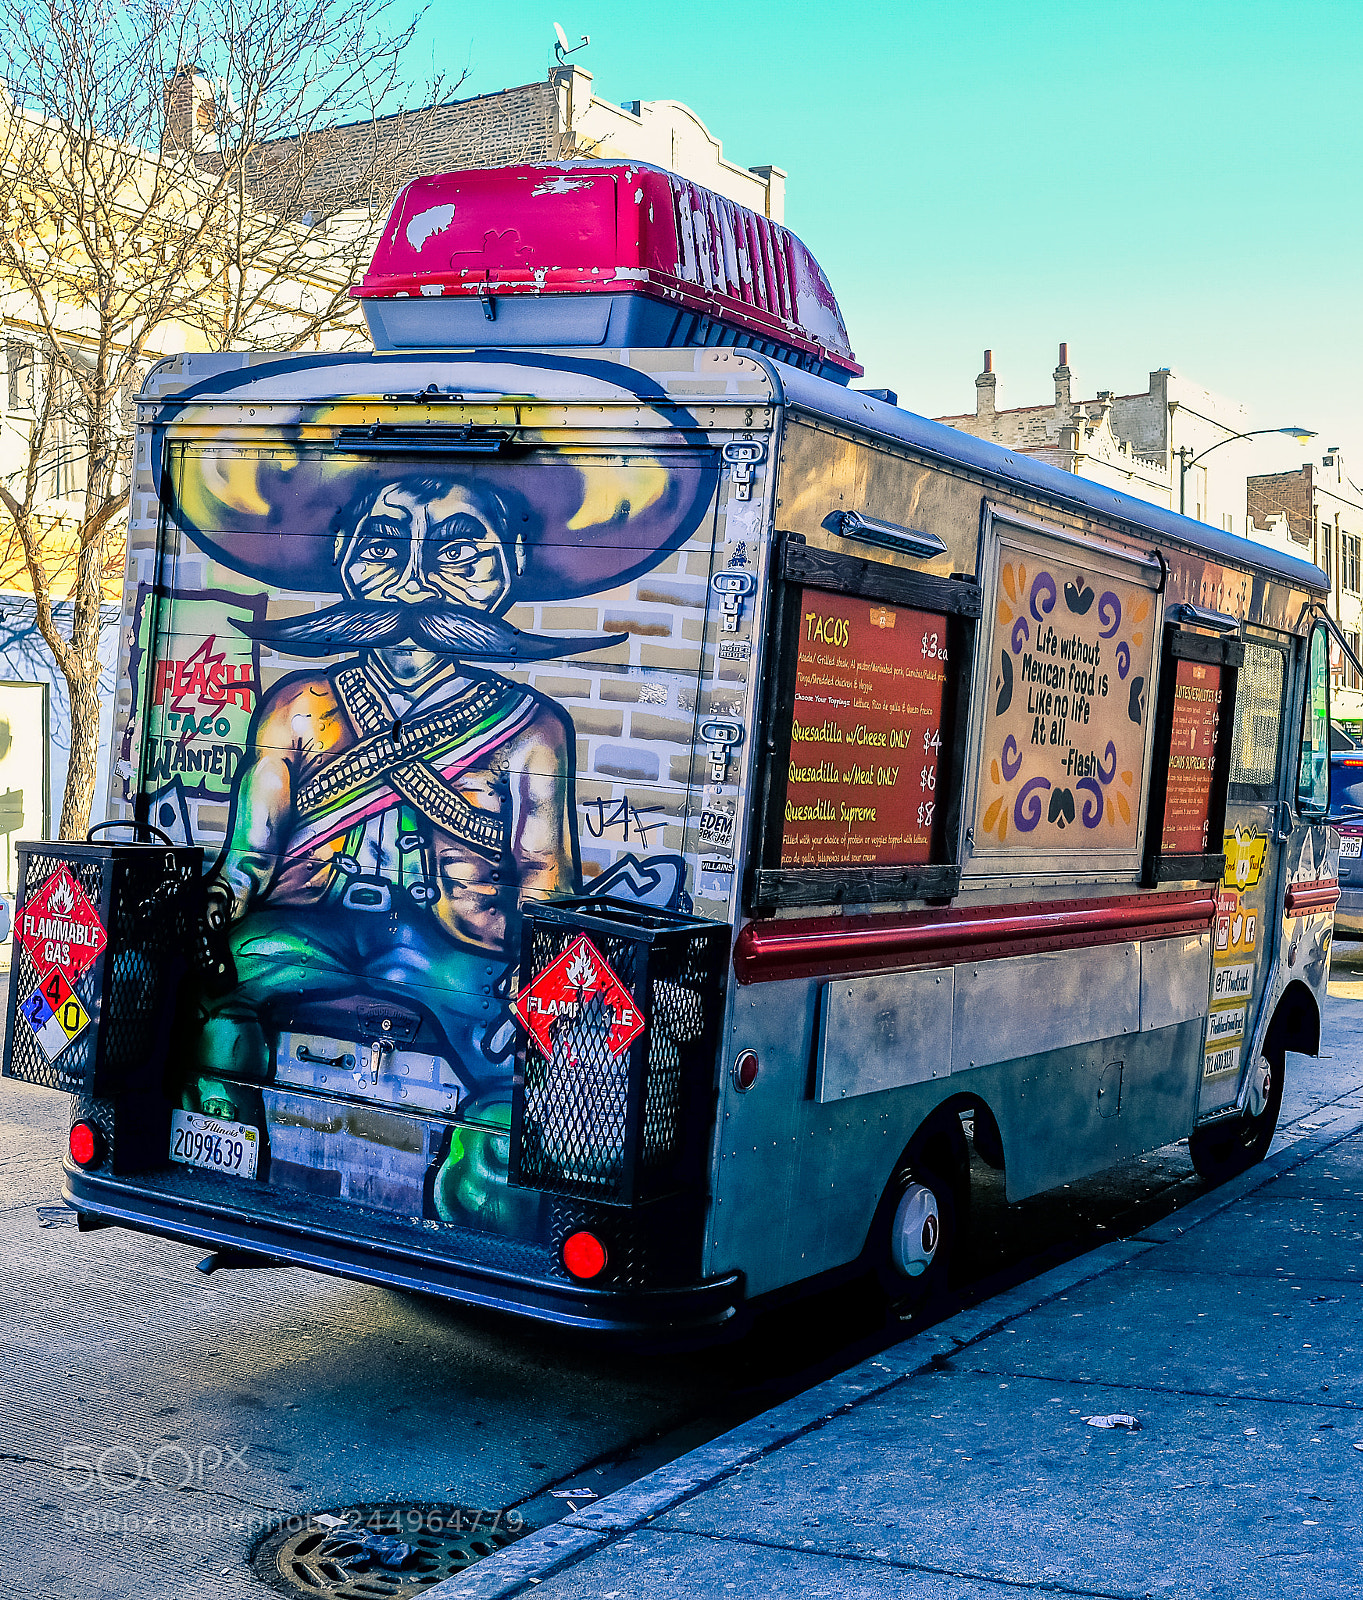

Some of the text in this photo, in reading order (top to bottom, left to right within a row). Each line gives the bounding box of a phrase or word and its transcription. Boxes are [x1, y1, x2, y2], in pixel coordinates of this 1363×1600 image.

[805, 612, 850, 648] TACOS
[1036, 624, 1100, 667] Life without
[817, 654, 835, 666] Grilled
[1021, 653, 1108, 697] Mexican food is
[153, 660, 253, 715] FLASH
[835, 676, 853, 688] chicken
[795, 693, 813, 702] Choose
[814, 695, 827, 704] Your
[882, 700, 889, 710] de
[889, 701, 901, 715] gallo
[919, 702, 933, 716] fresco
[1027, 686, 1090, 725] Like no life
[167, 712, 231, 737] TACO
[791, 719, 942, 756] Quesadilla w/Cheese ONLY $4
[1031, 716, 1046, 746] At
[146, 738, 246, 785] WANTED
[788, 760, 936, 793] Quesadilla w/Meat ONLY $6
[700, 811, 734, 835] EDEM
[784, 798, 935, 833] Quesadilla Supreme $8
[783, 833, 799, 845] Filled
[799, 834, 811, 844] with
[811, 837, 823, 851] your
[824, 834, 839, 844] choice
[840, 831, 847, 847] of
[847, 834, 863, 850] protein
[864, 836, 870, 844] or
[871, 835, 887, 848] veggies
[888, 833, 903, 849] topped
[793, 851, 800, 863] de
[840, 851, 850, 862] and
[851, 854, 862, 862] sour
[862, 854, 877, 862] cream
[23, 914, 100, 948] FLAMMABLE
[44, 941, 71, 967] GAS
[46, 974, 61, 1005] 4
[30, 995, 44, 1025] 2
[63, 1001, 81, 1032] 0
[192, 1118, 239, 1138] Illinois
[173, 1128, 243, 1170] 2099639
